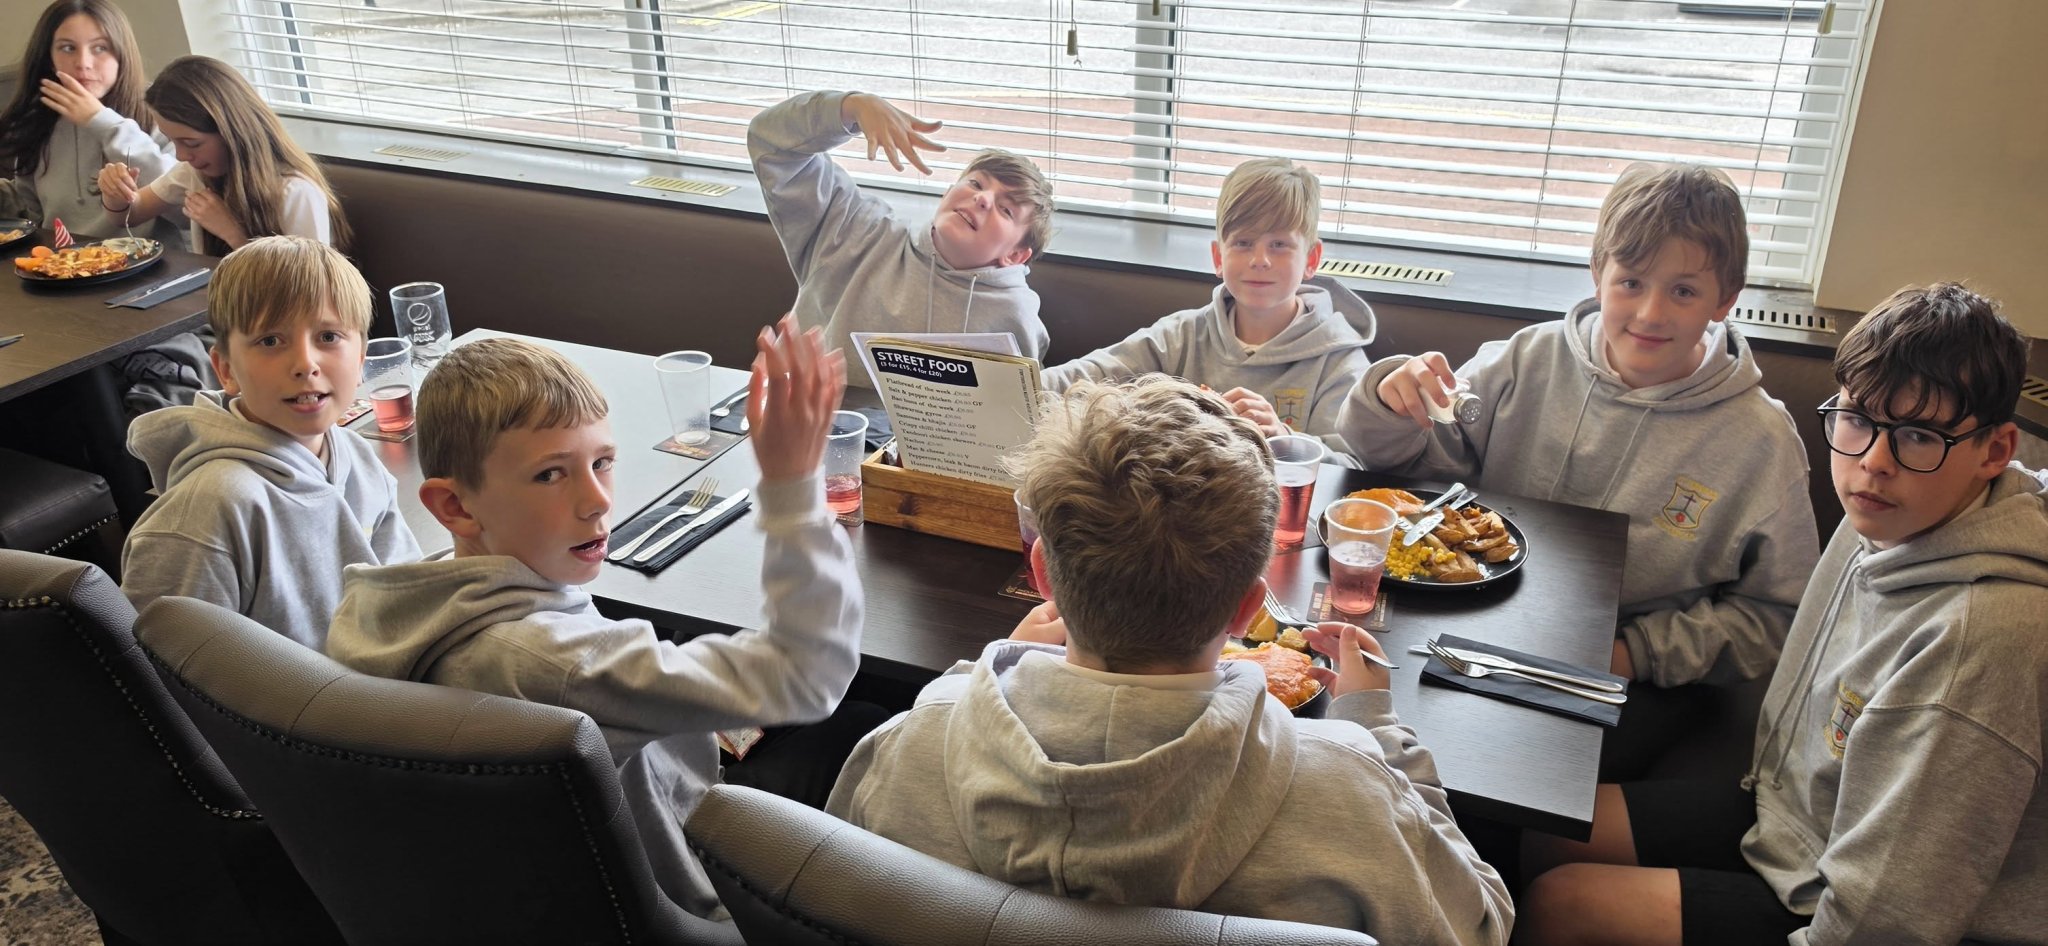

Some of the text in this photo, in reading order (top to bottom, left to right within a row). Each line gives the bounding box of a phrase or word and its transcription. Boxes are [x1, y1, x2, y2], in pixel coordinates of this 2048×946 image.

[877, 351, 968, 374] STREET FOOD
[918, 367, 927, 375] for
[928, 370, 942, 378] £20)
[886, 378, 914, 388] Flatbread
[908, 391, 928, 399] pepper
[929, 395, 952, 403] chicken
[895, 404, 923, 414] Shawarma
[899, 420, 917, 429] Crispy
[935, 427, 958, 435] chicken
[902, 429, 928, 438] Tandoori
[929, 432, 951, 441] chicken
[952, 436, 977, 445] skewers
[926, 447, 945, 455] cheese
[935, 464, 957, 473] chicken
[958, 468, 972, 477] dirty
[973, 471, 987, 479] fries
[963, 461, 980, 469] bacon
[981, 465, 996, 474] dirty
